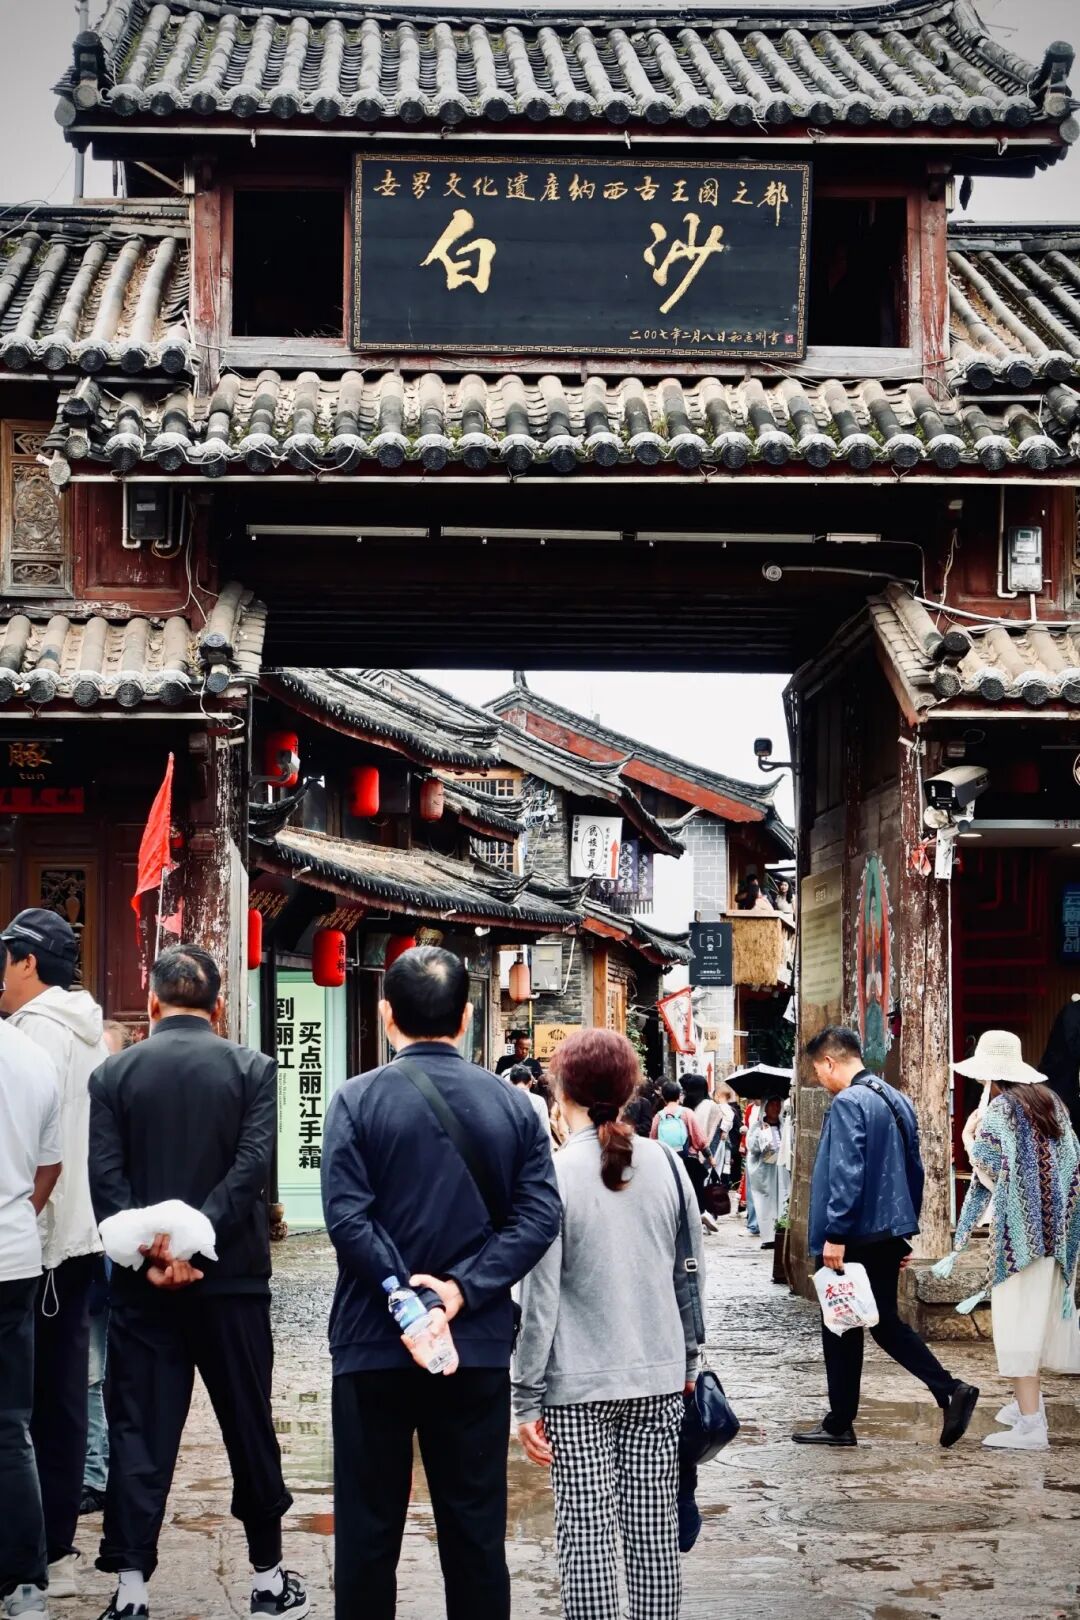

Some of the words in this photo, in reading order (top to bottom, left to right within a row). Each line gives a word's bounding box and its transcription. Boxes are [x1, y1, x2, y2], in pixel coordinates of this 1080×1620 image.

[420, 208, 725, 314] 白沙
[299, 1021, 322, 1169] 买点丽江手霜
